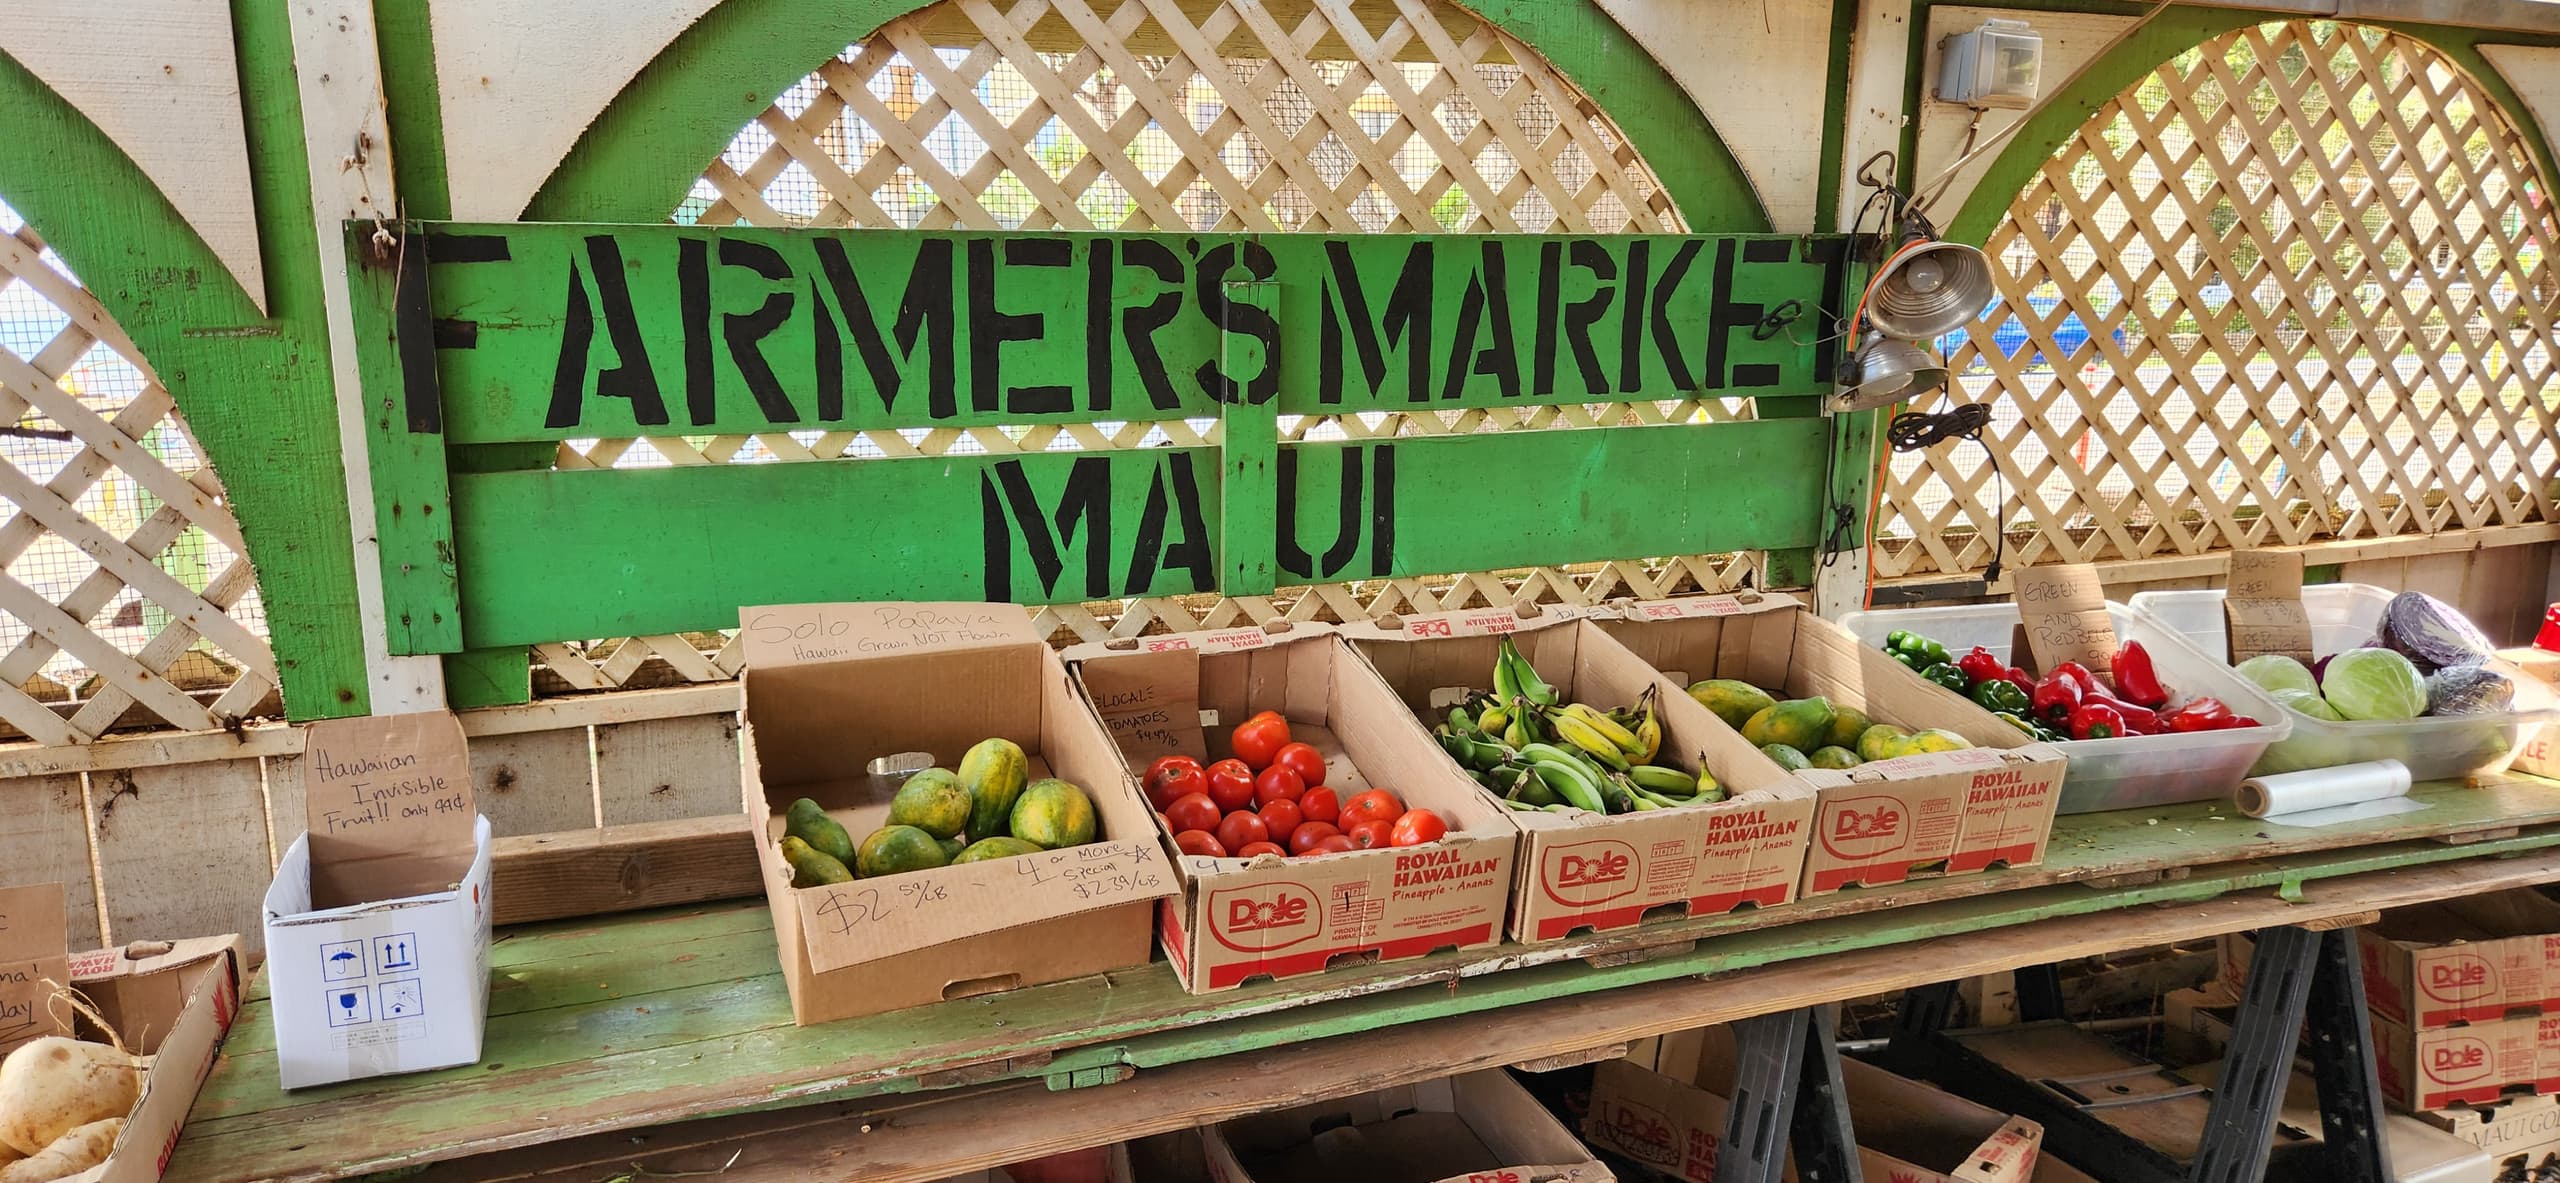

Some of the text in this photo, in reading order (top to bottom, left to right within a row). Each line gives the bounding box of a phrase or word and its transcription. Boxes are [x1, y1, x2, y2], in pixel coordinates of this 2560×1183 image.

[396, 234, 1883, 434] FARMER'S MARKET
[981, 444, 1395, 603] MAUI
[2024, 581, 2077, 602] GREEN
[750, 612, 850, 643] Solo
[1411, 619, 1452, 637] Dole
[1465, 615, 1513, 627] HAWAIIAN
[1487, 623, 1516, 634] ROYAL
[2044, 613, 2081, 627] AND
[914, 631, 950, 645] NOT
[1207, 632, 1260, 645] HAWAIIAN
[1231, 639, 1263, 648] ROYAL
[1105, 710, 1169, 731] TOMATOES
[315, 748, 416, 783] Hawaiian
[352, 776, 449, 805] Invisible
[1972, 771, 2023, 789] ROYAL
[1968, 782, 2049, 804] HAWAIIAN
[1709, 810, 1766, 830] ROYAL
[1834, 806, 1899, 840] Dole
[1705, 820, 1798, 846] HAWAIIAN
[1396, 849, 1460, 871] ROYAL
[1703, 839, 1793, 860] Pineapple Ananas
[1016, 856, 1043, 884] 4
[1050, 854, 1068, 865] or
[1394, 857, 1498, 887] HAWAIIAN
[1558, 851, 1629, 886] Dole
[1392, 878, 1494, 902] Pineapple Ananas
[1229, 893, 1308, 931] Dole
[71, 963, 114, 977] ROYA
[2433, 962, 2486, 986] Dole
[2435, 1045, 2484, 1069] Dole
